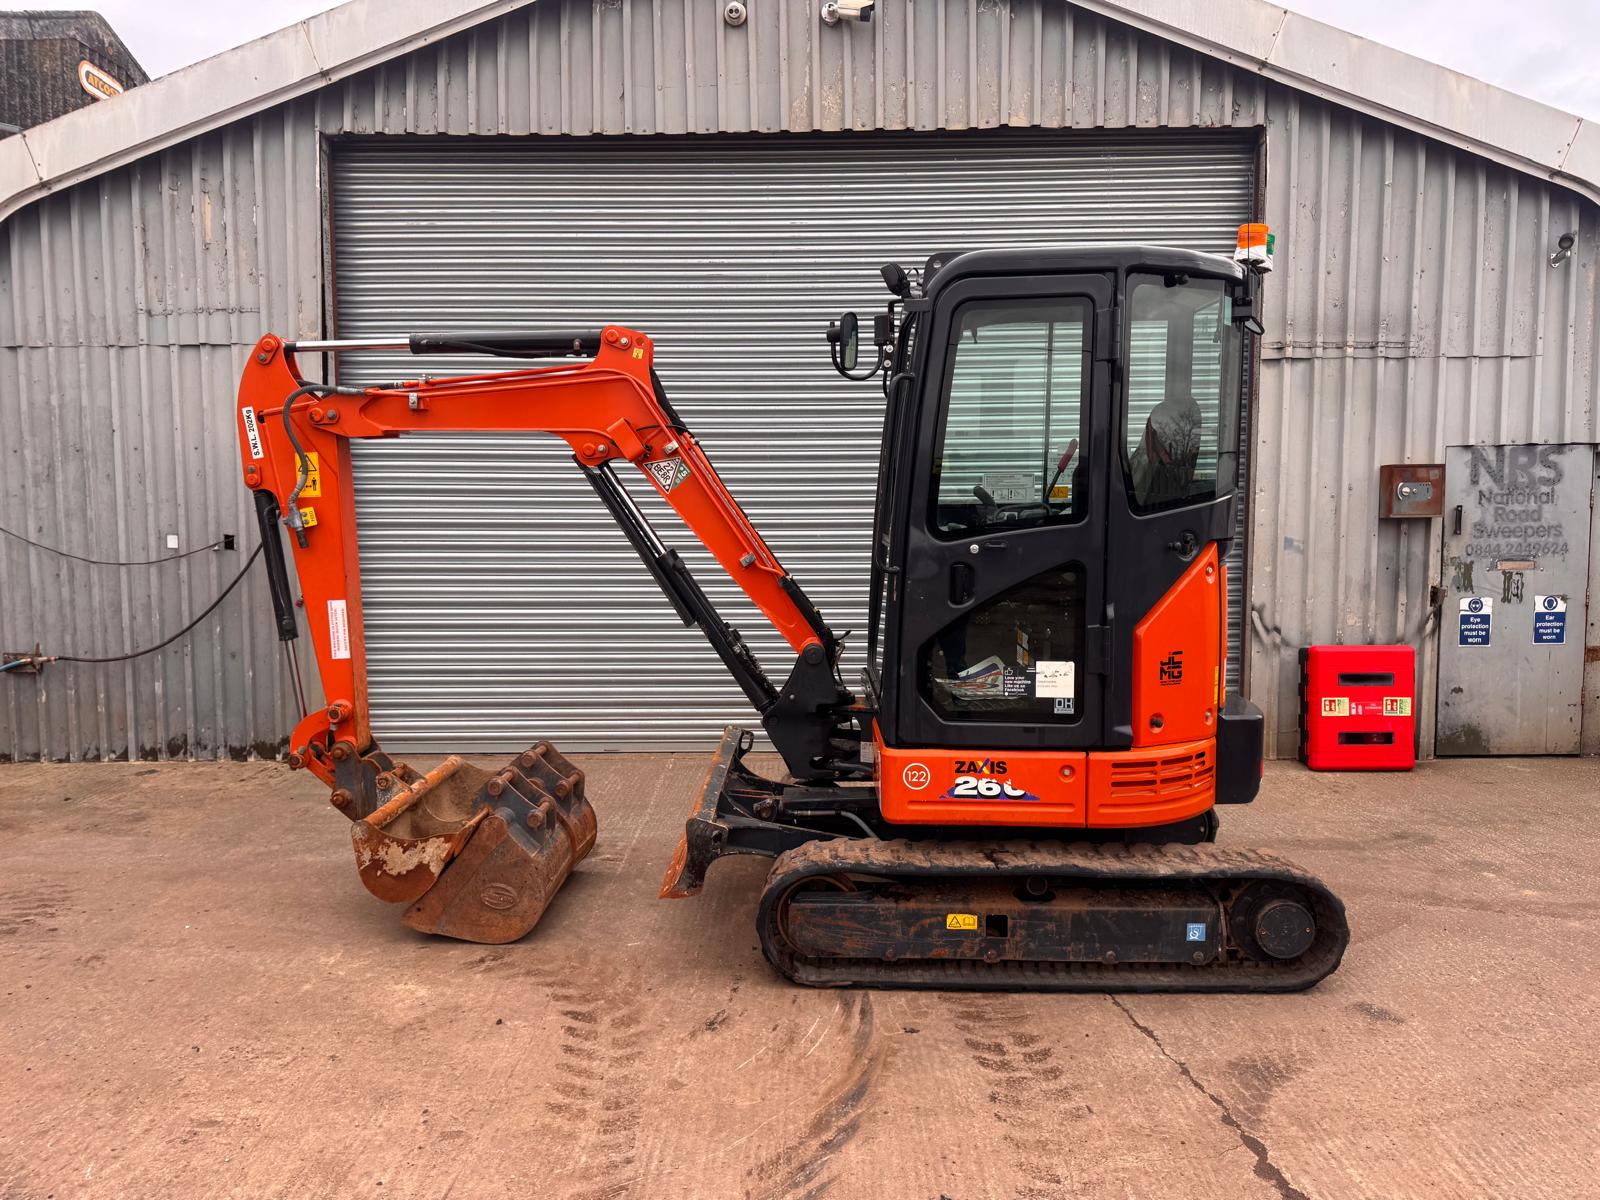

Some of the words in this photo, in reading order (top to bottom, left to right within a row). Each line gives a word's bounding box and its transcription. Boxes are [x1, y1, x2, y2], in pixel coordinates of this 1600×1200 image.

[88, 73, 120, 96] ATCOS
[245, 409, 255, 433] 202Kg
[250, 434, 260, 456] S.W.L.
[663, 462, 674, 474] 22
[1470, 446, 1564, 491] NRS
[1478, 487, 1555, 506] National
[1494, 505, 1542, 522] Road
[1473, 520, 1563, 542] Sweepers
[955, 758, 1007, 774] ZAXIS
[907, 771, 927, 782] 122
